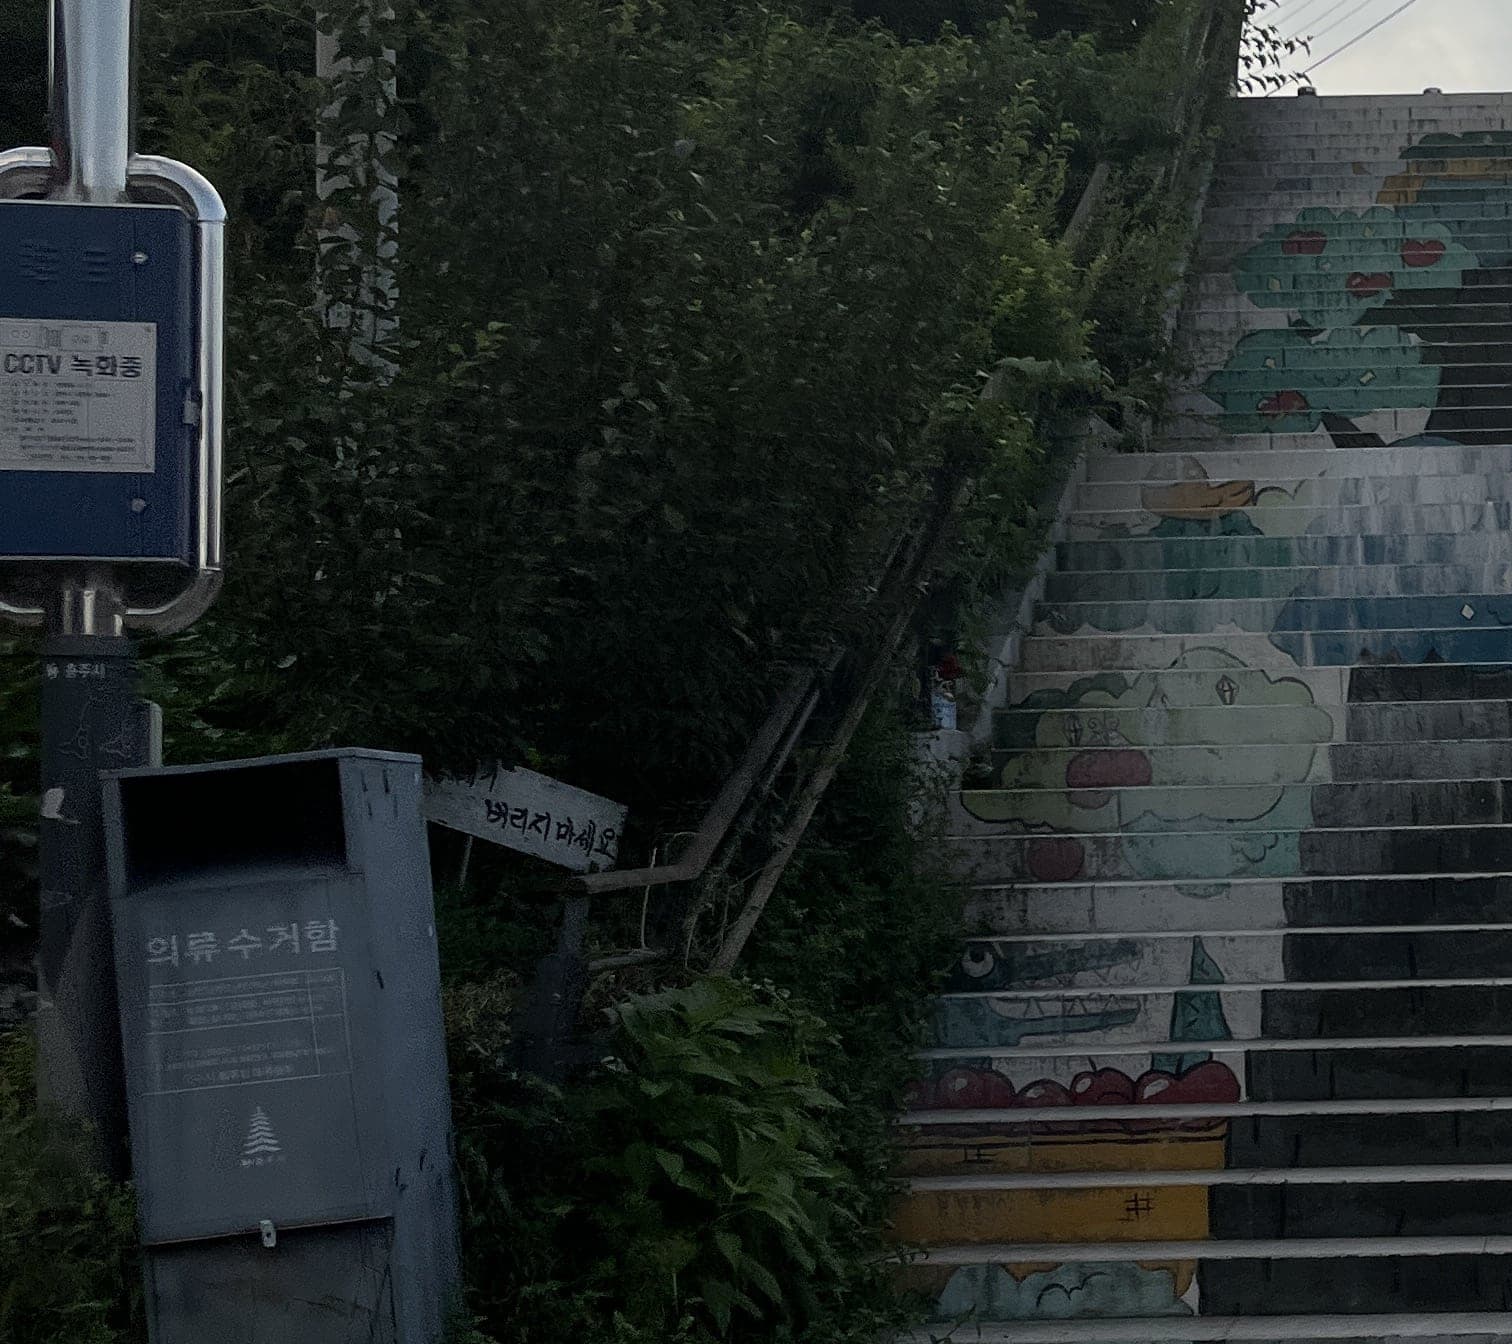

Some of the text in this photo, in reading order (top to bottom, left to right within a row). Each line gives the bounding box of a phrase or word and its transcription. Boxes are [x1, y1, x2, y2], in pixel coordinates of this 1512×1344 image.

[4, 353, 142, 378] CCTV 녹화중
[484, 799, 551, 841] 버리지
